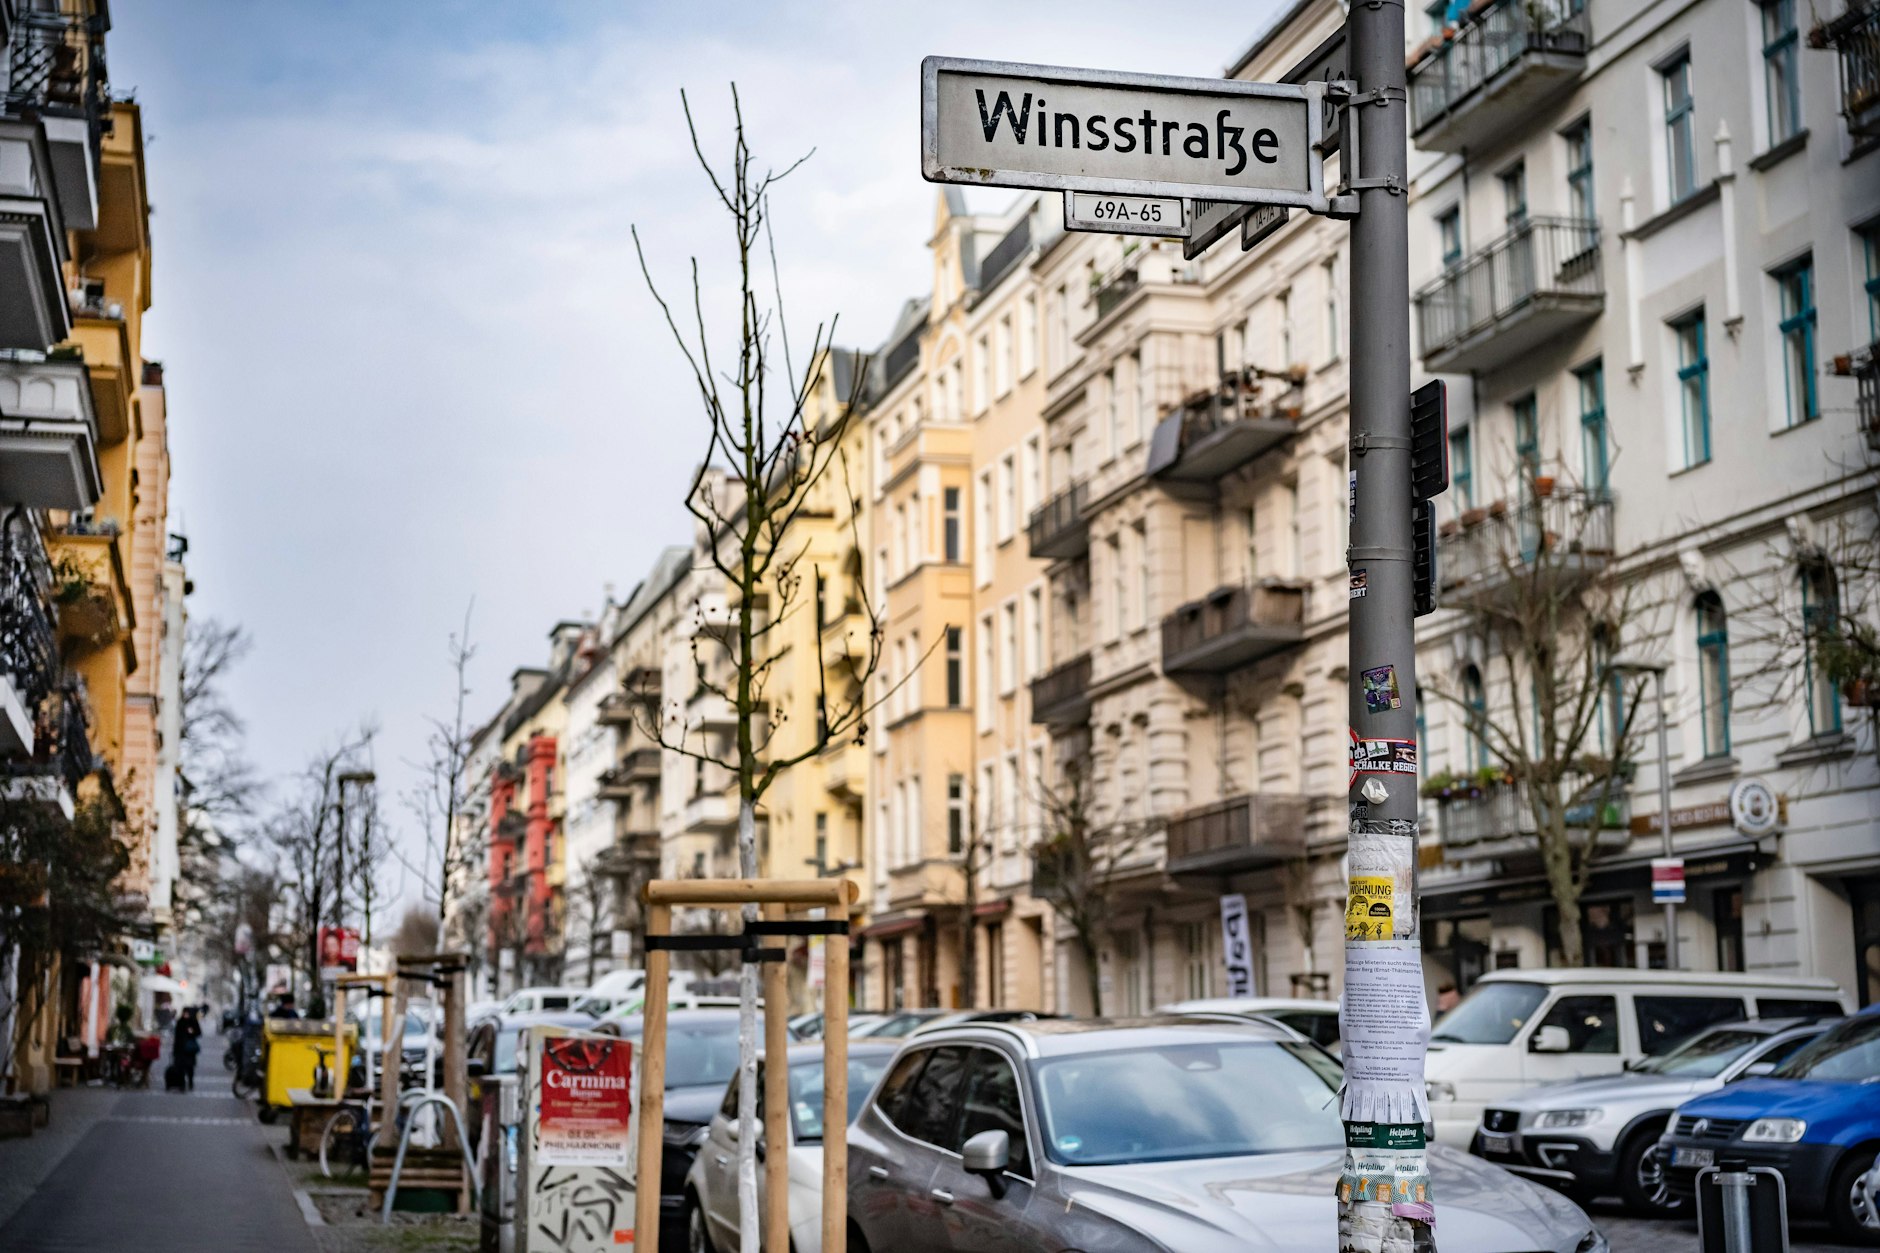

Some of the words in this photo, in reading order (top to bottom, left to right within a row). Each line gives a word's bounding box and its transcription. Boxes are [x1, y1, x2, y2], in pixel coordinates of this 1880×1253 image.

[975, 88, 1279, 176] Winsstraße
[1094, 201, 1162, 223] 69A-65
[1354, 760, 1391, 771] SCHALKE
[546, 1069, 626, 1089] Carmina
[1389, 1128, 1417, 1138] Helpling
[1357, 1162, 1385, 1172] Helpling
